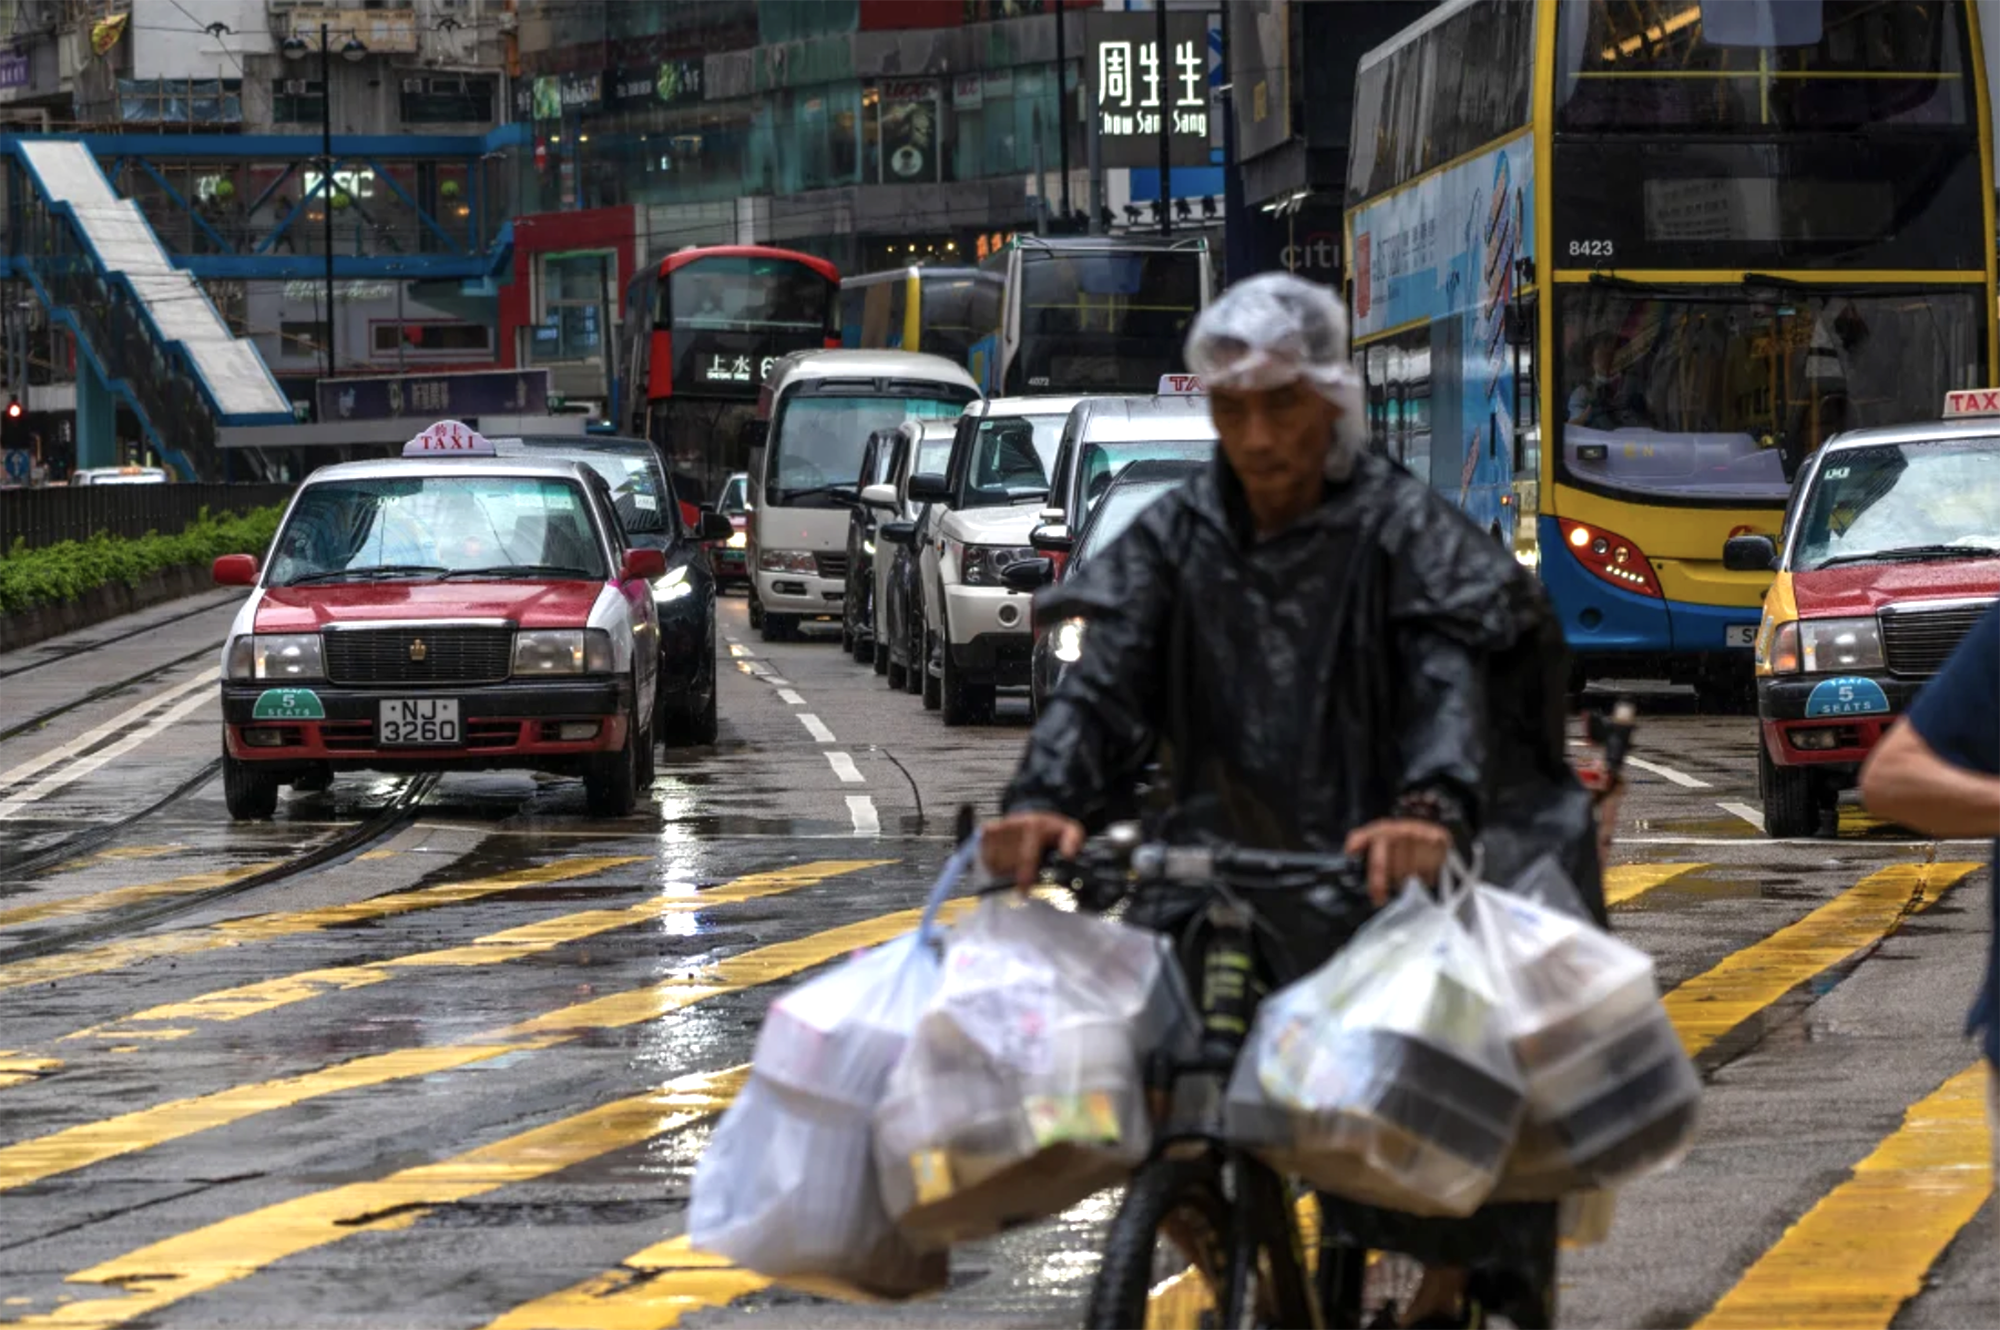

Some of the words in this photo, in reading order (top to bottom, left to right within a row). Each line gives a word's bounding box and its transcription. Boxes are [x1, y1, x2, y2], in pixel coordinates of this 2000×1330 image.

[1099, 40, 1204, 106] 周生生
[1099, 111, 1133, 135] how
[1137, 110, 1161, 134] San
[1173, 110, 1206, 137] Sang
[1280, 239, 1340, 269] citi
[1569, 240, 1613, 256] 8423
[706, 354, 751, 374] 上水
[1169, 376, 1205, 391] TA
[421, 435, 474, 449] TAXI
[282, 694, 295, 707] 5
[1838, 686, 1854, 702] 5
[267, 708, 310, 717] SEATS
[402, 701, 437, 720] NJ
[1822, 701, 1871, 713] SEATS
[384, 720, 456, 742] 3260
